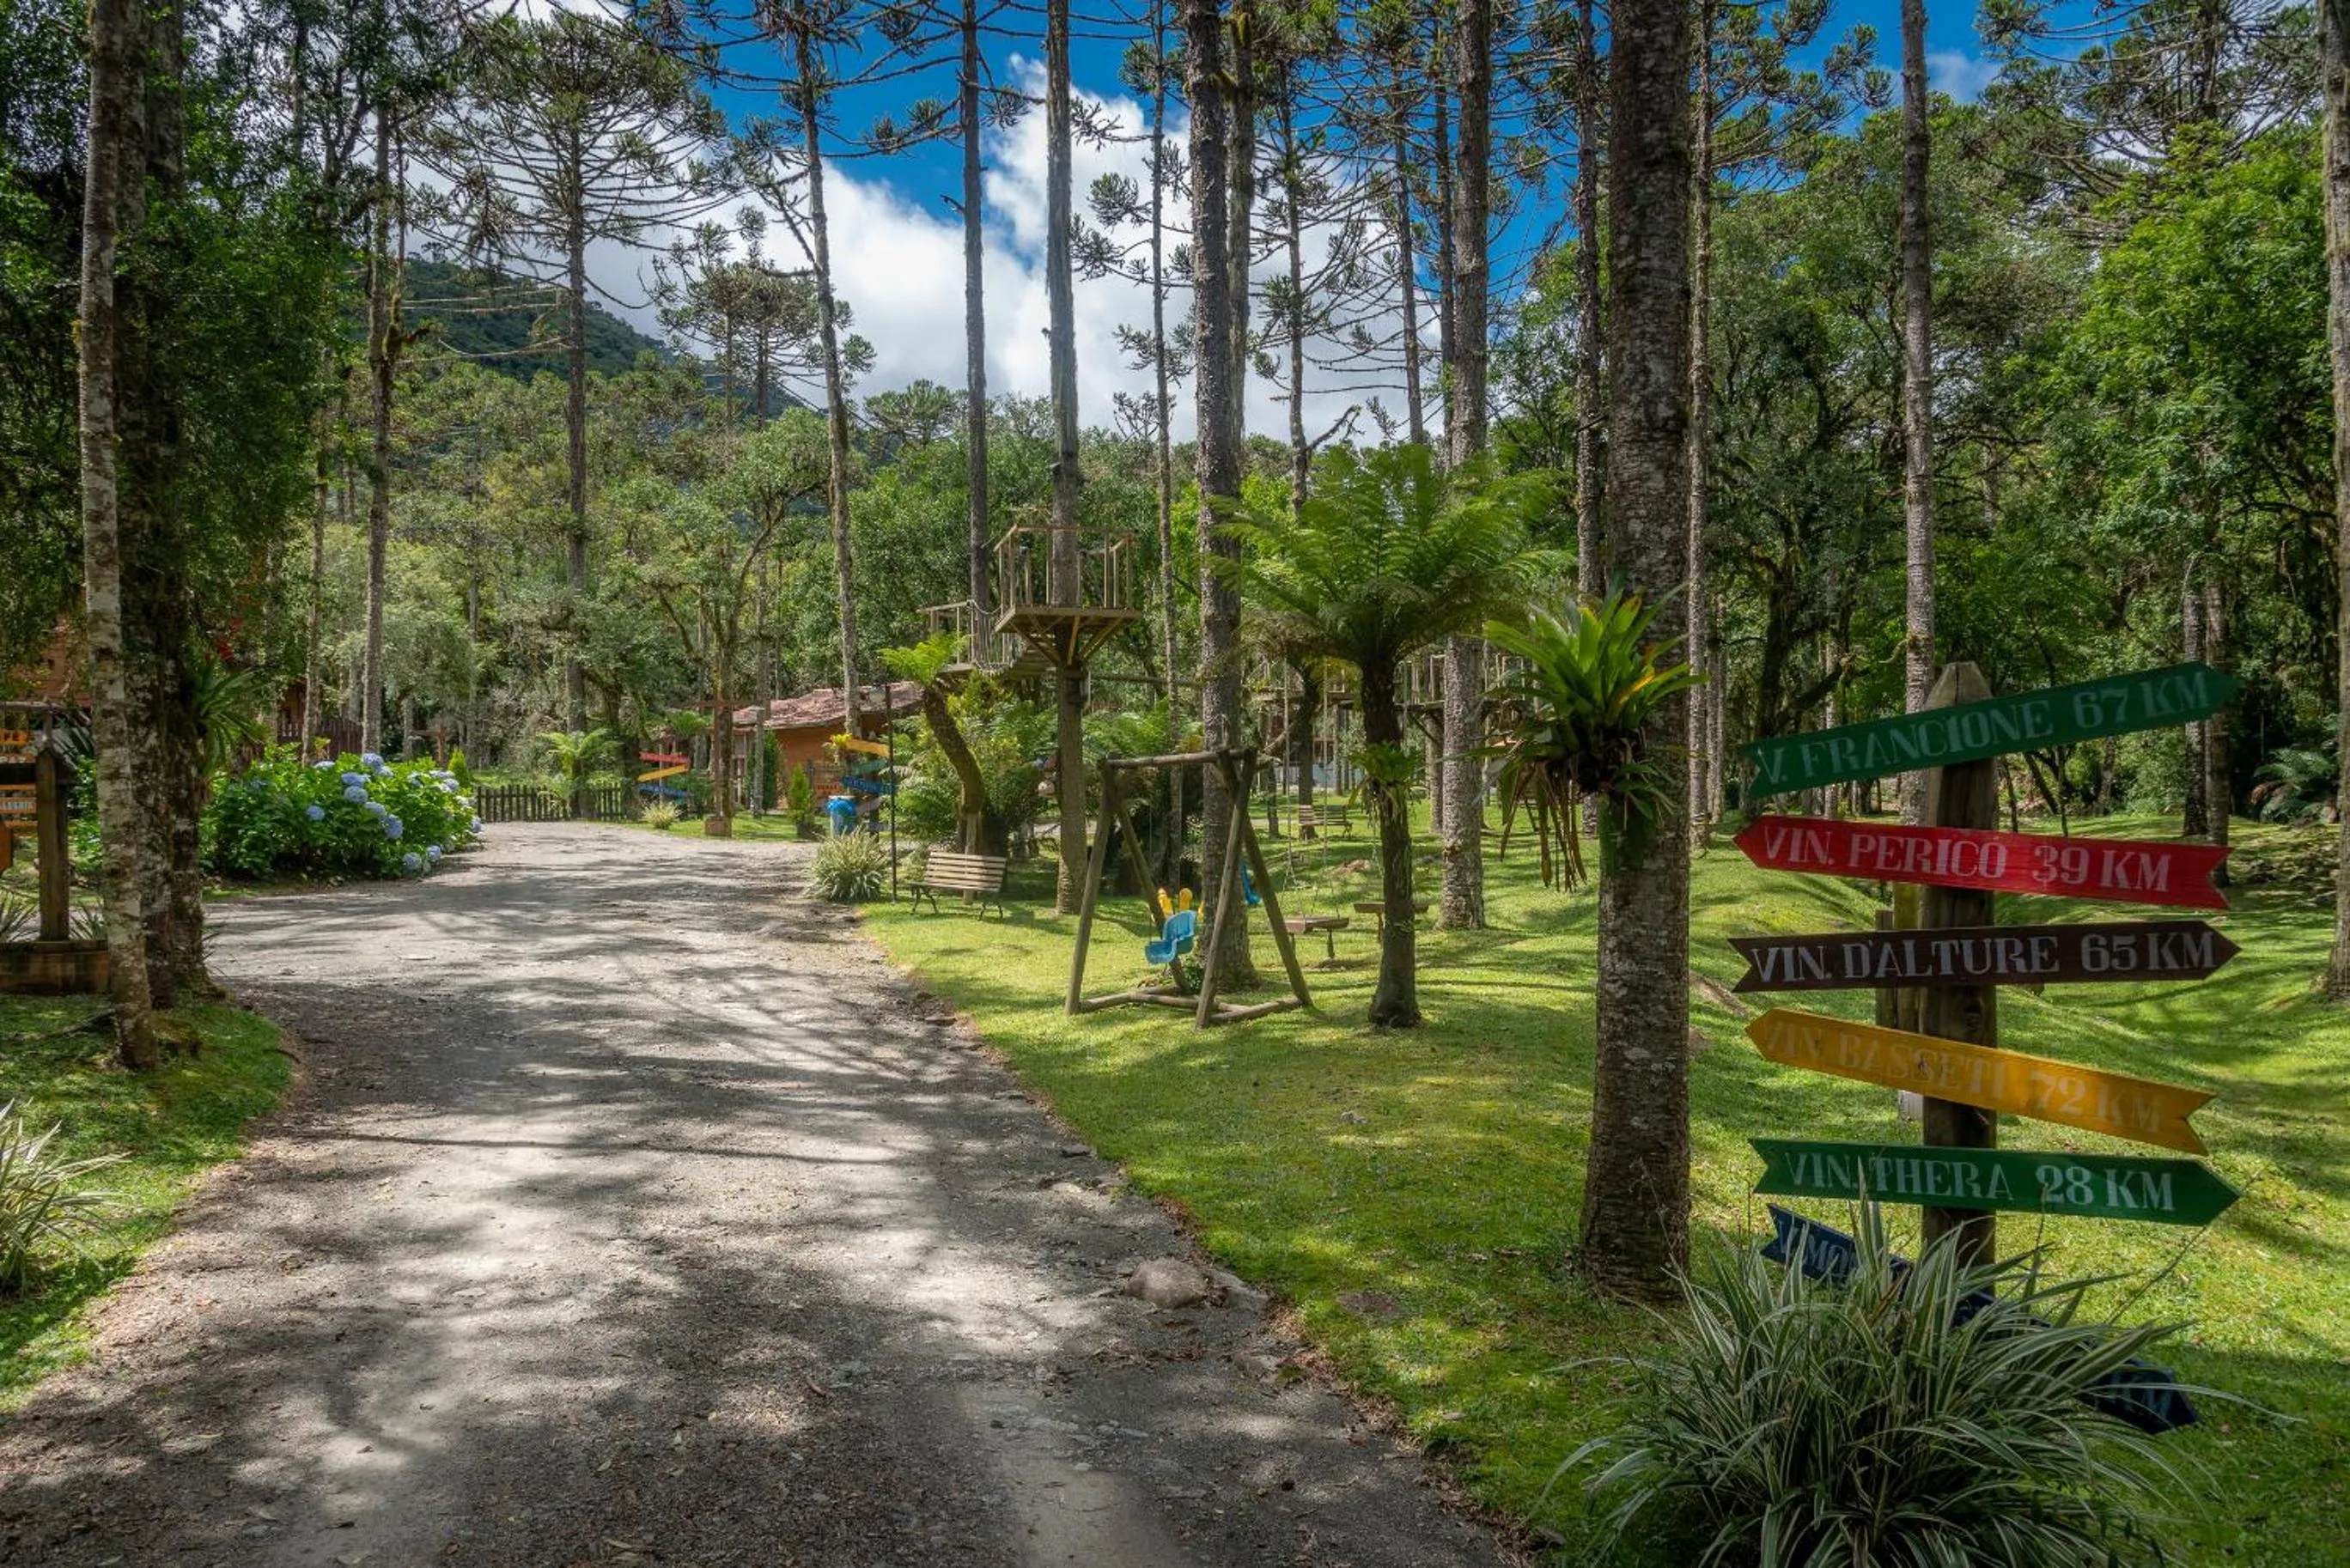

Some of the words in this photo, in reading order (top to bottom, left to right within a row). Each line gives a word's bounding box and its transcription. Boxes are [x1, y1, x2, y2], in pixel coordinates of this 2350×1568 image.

[1757, 748, 1788, 785] V.
[1801, 698, 2054, 778] FRANCIONE
[2072, 686, 2129, 728] 67
[2139, 671, 2209, 718] KM
[1763, 826, 1835, 866] VIN.
[1847, 833, 2007, 878] PERICO
[2031, 845, 2090, 885] 39
[2100, 849, 2171, 892] KM
[1750, 945, 1833, 983] VIN.
[1842, 935, 2060, 979] D'ALTURE
[2081, 933, 2138, 972] 65
[2146, 931, 2218, 970] KM
[2030, 1069, 2086, 1116] 72
[2097, 1082, 2164, 1133] KM
[1868, 1156, 2014, 1201] THERA
[2035, 1164, 2094, 1206] 28
[2105, 1169, 2176, 1212] KM
